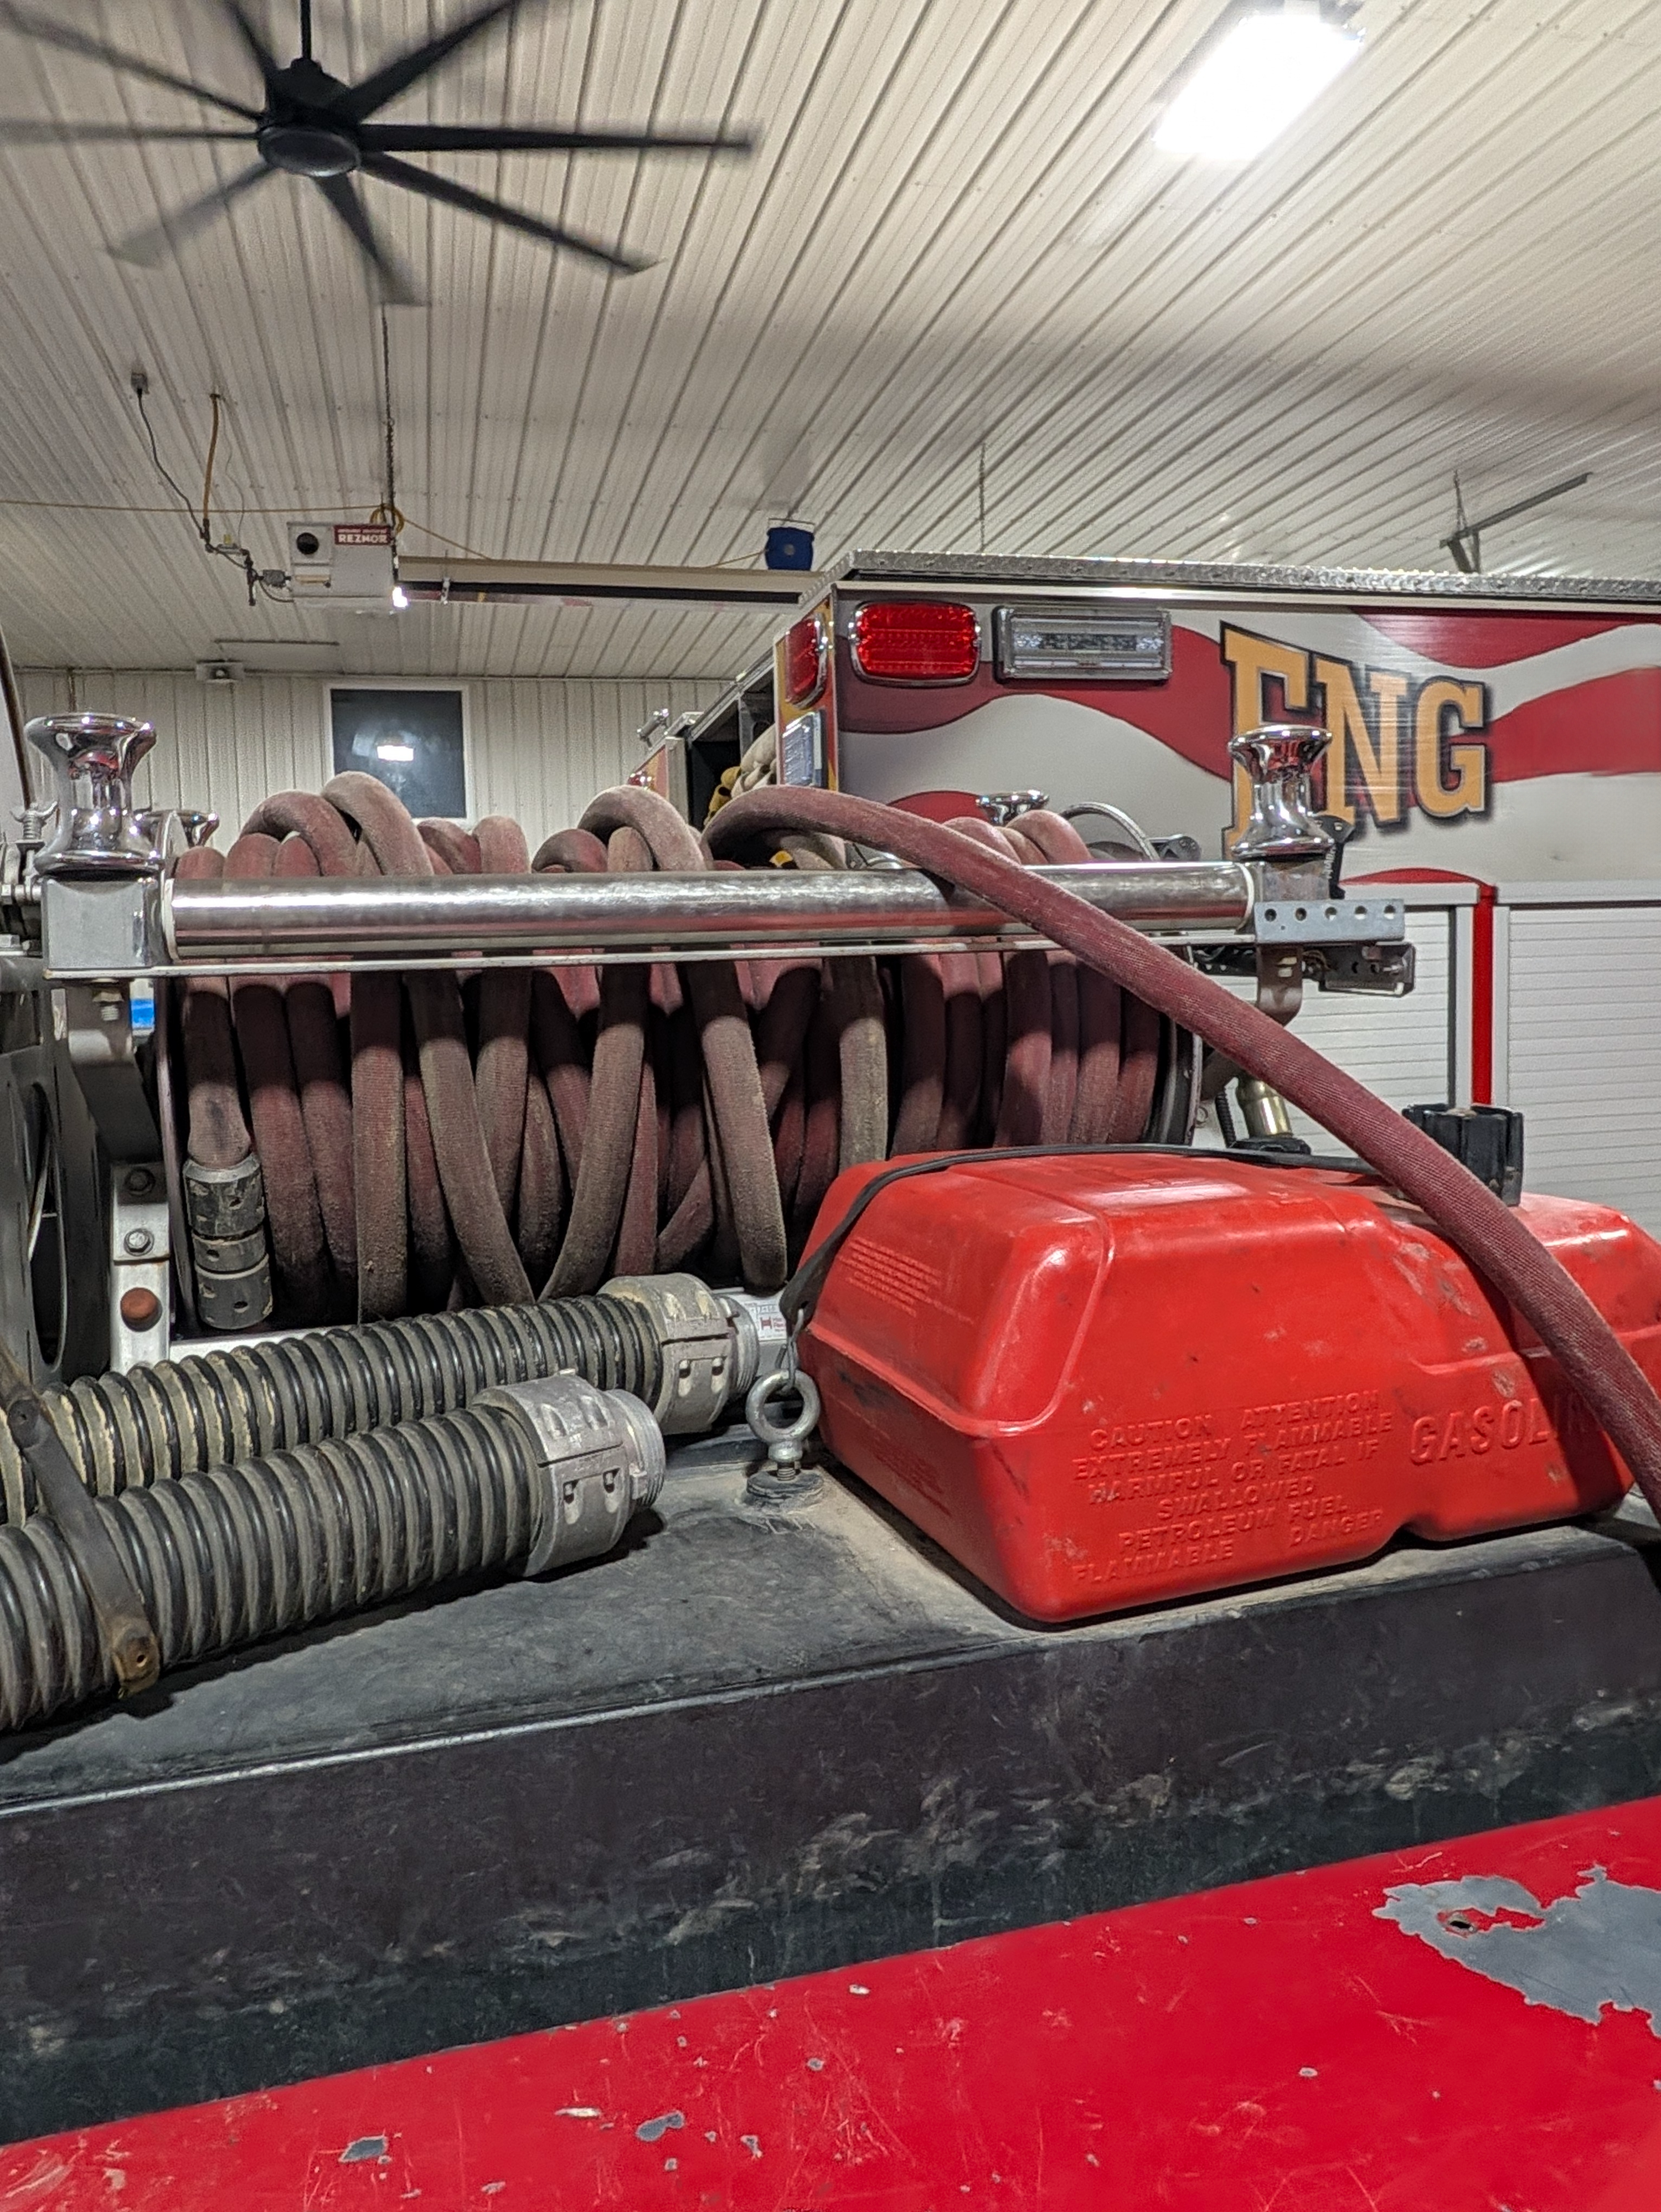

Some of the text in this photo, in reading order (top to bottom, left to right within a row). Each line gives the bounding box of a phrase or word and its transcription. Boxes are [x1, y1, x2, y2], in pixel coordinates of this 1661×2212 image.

[338, 534, 388, 543] REZNOR
[1072, 1412, 1392, 1481] EXTREMELY FLAMMABLE
[1091, 1389, 1380, 1451] CAUTION ATTENTION
[1410, 1392, 1600, 1466] GASOLIN
[1089, 1439, 1379, 1504] HARMFUL OR FATAL IF
[1157, 1475, 1314, 1520] SWALLOWED
[1071, 1509, 1383, 1584] FLAMMABLE DANGER
[1118, 1494, 1347, 1555] PETROLEUM FUEL
